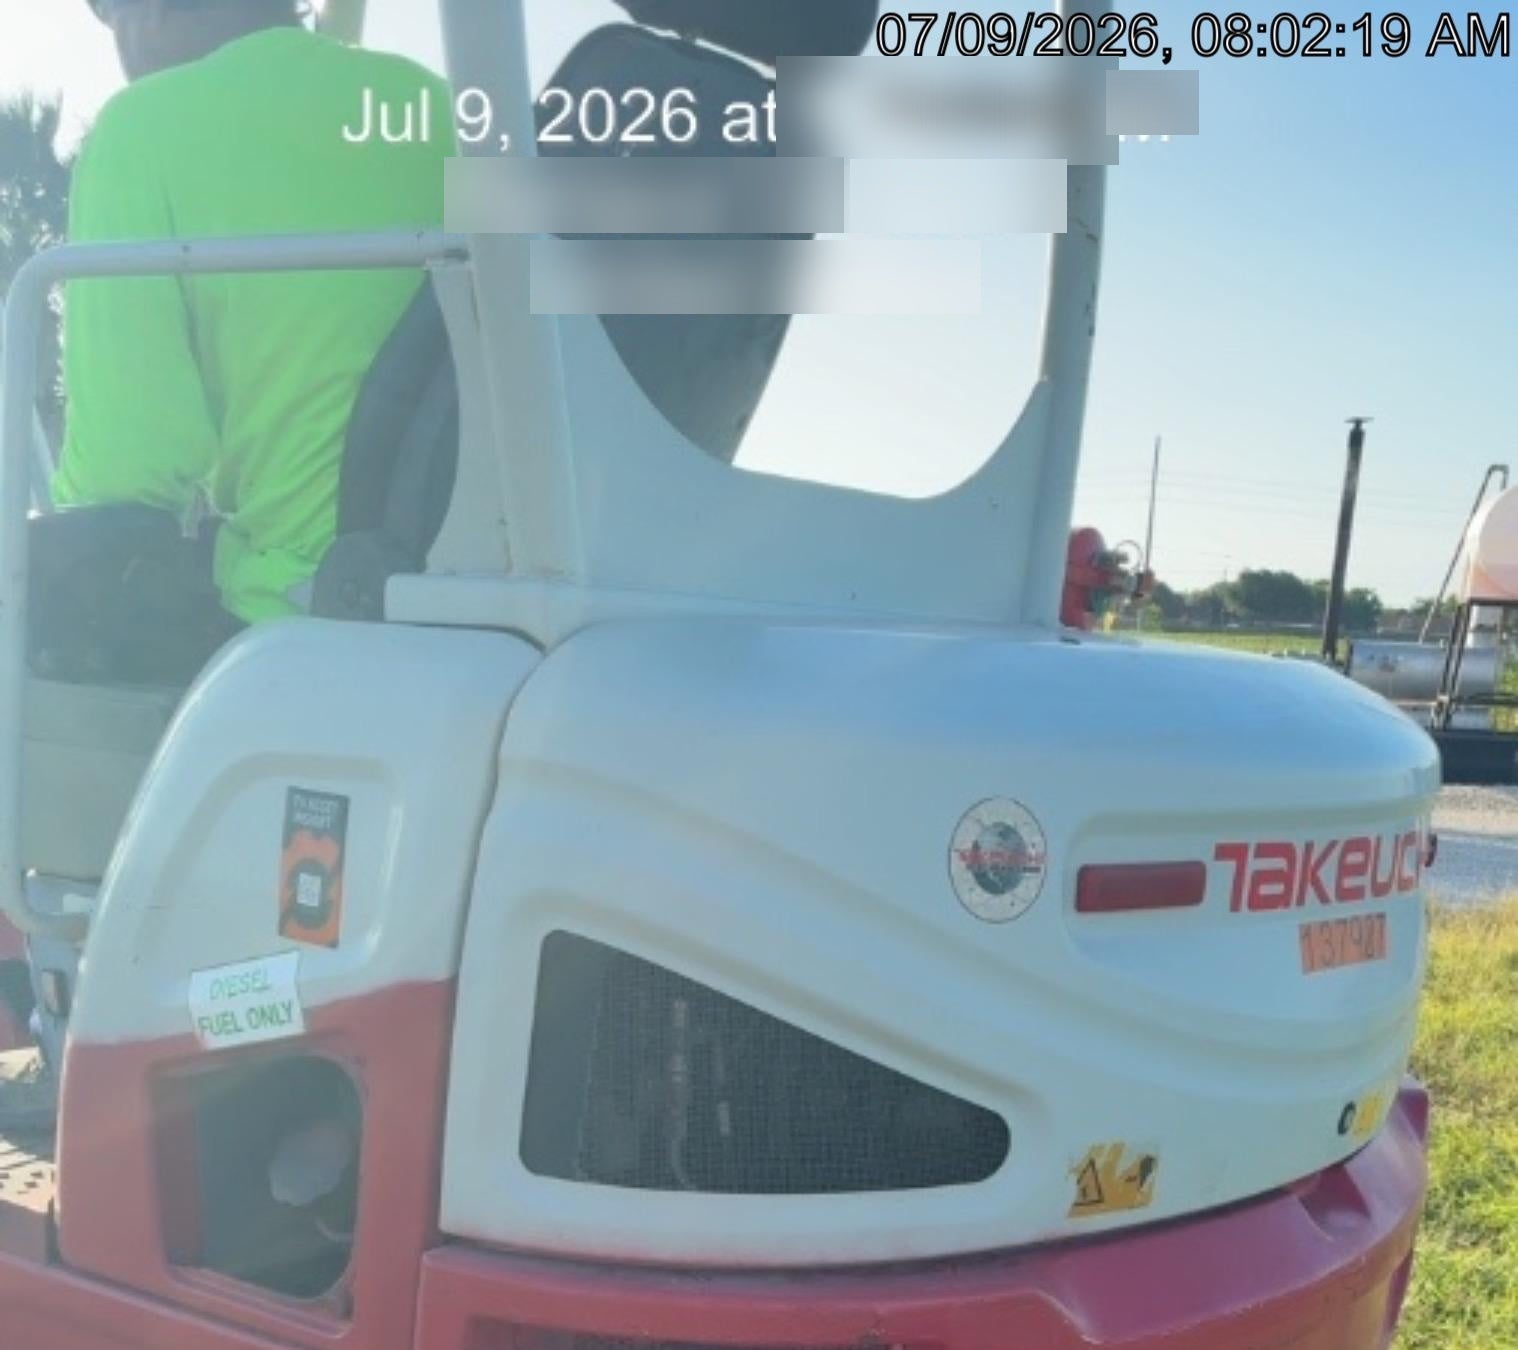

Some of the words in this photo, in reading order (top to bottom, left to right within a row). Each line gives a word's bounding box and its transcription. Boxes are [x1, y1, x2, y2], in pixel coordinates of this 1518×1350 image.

[209, 968, 271, 1001] DIESEL
[197, 1010, 244, 1038] FUEL
[246, 999, 293, 1030] ONLY
